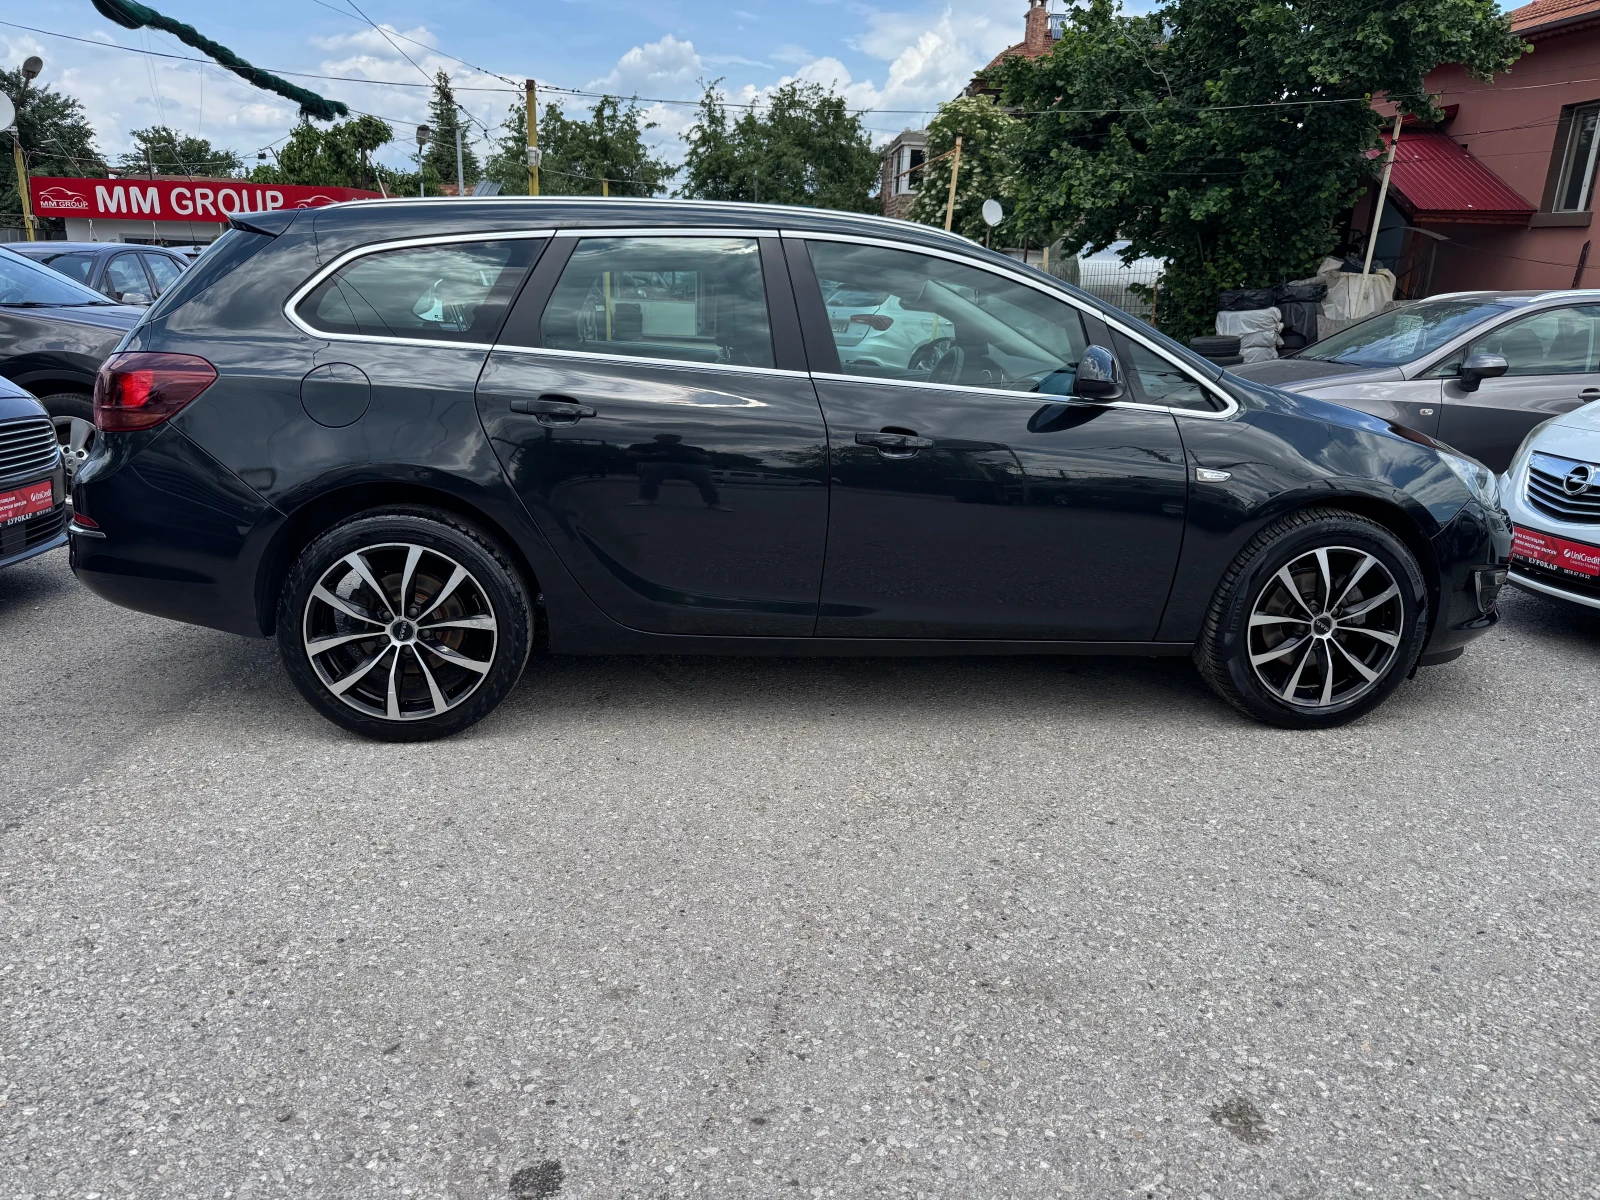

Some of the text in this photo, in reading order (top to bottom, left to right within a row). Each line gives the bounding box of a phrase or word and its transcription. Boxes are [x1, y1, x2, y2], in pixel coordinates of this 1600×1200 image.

[95, 185, 284, 216] MM GROUP
[1528, 557, 1558, 571] ЕУРОКАР
[1570, 551, 1600, 566] UniCredit
